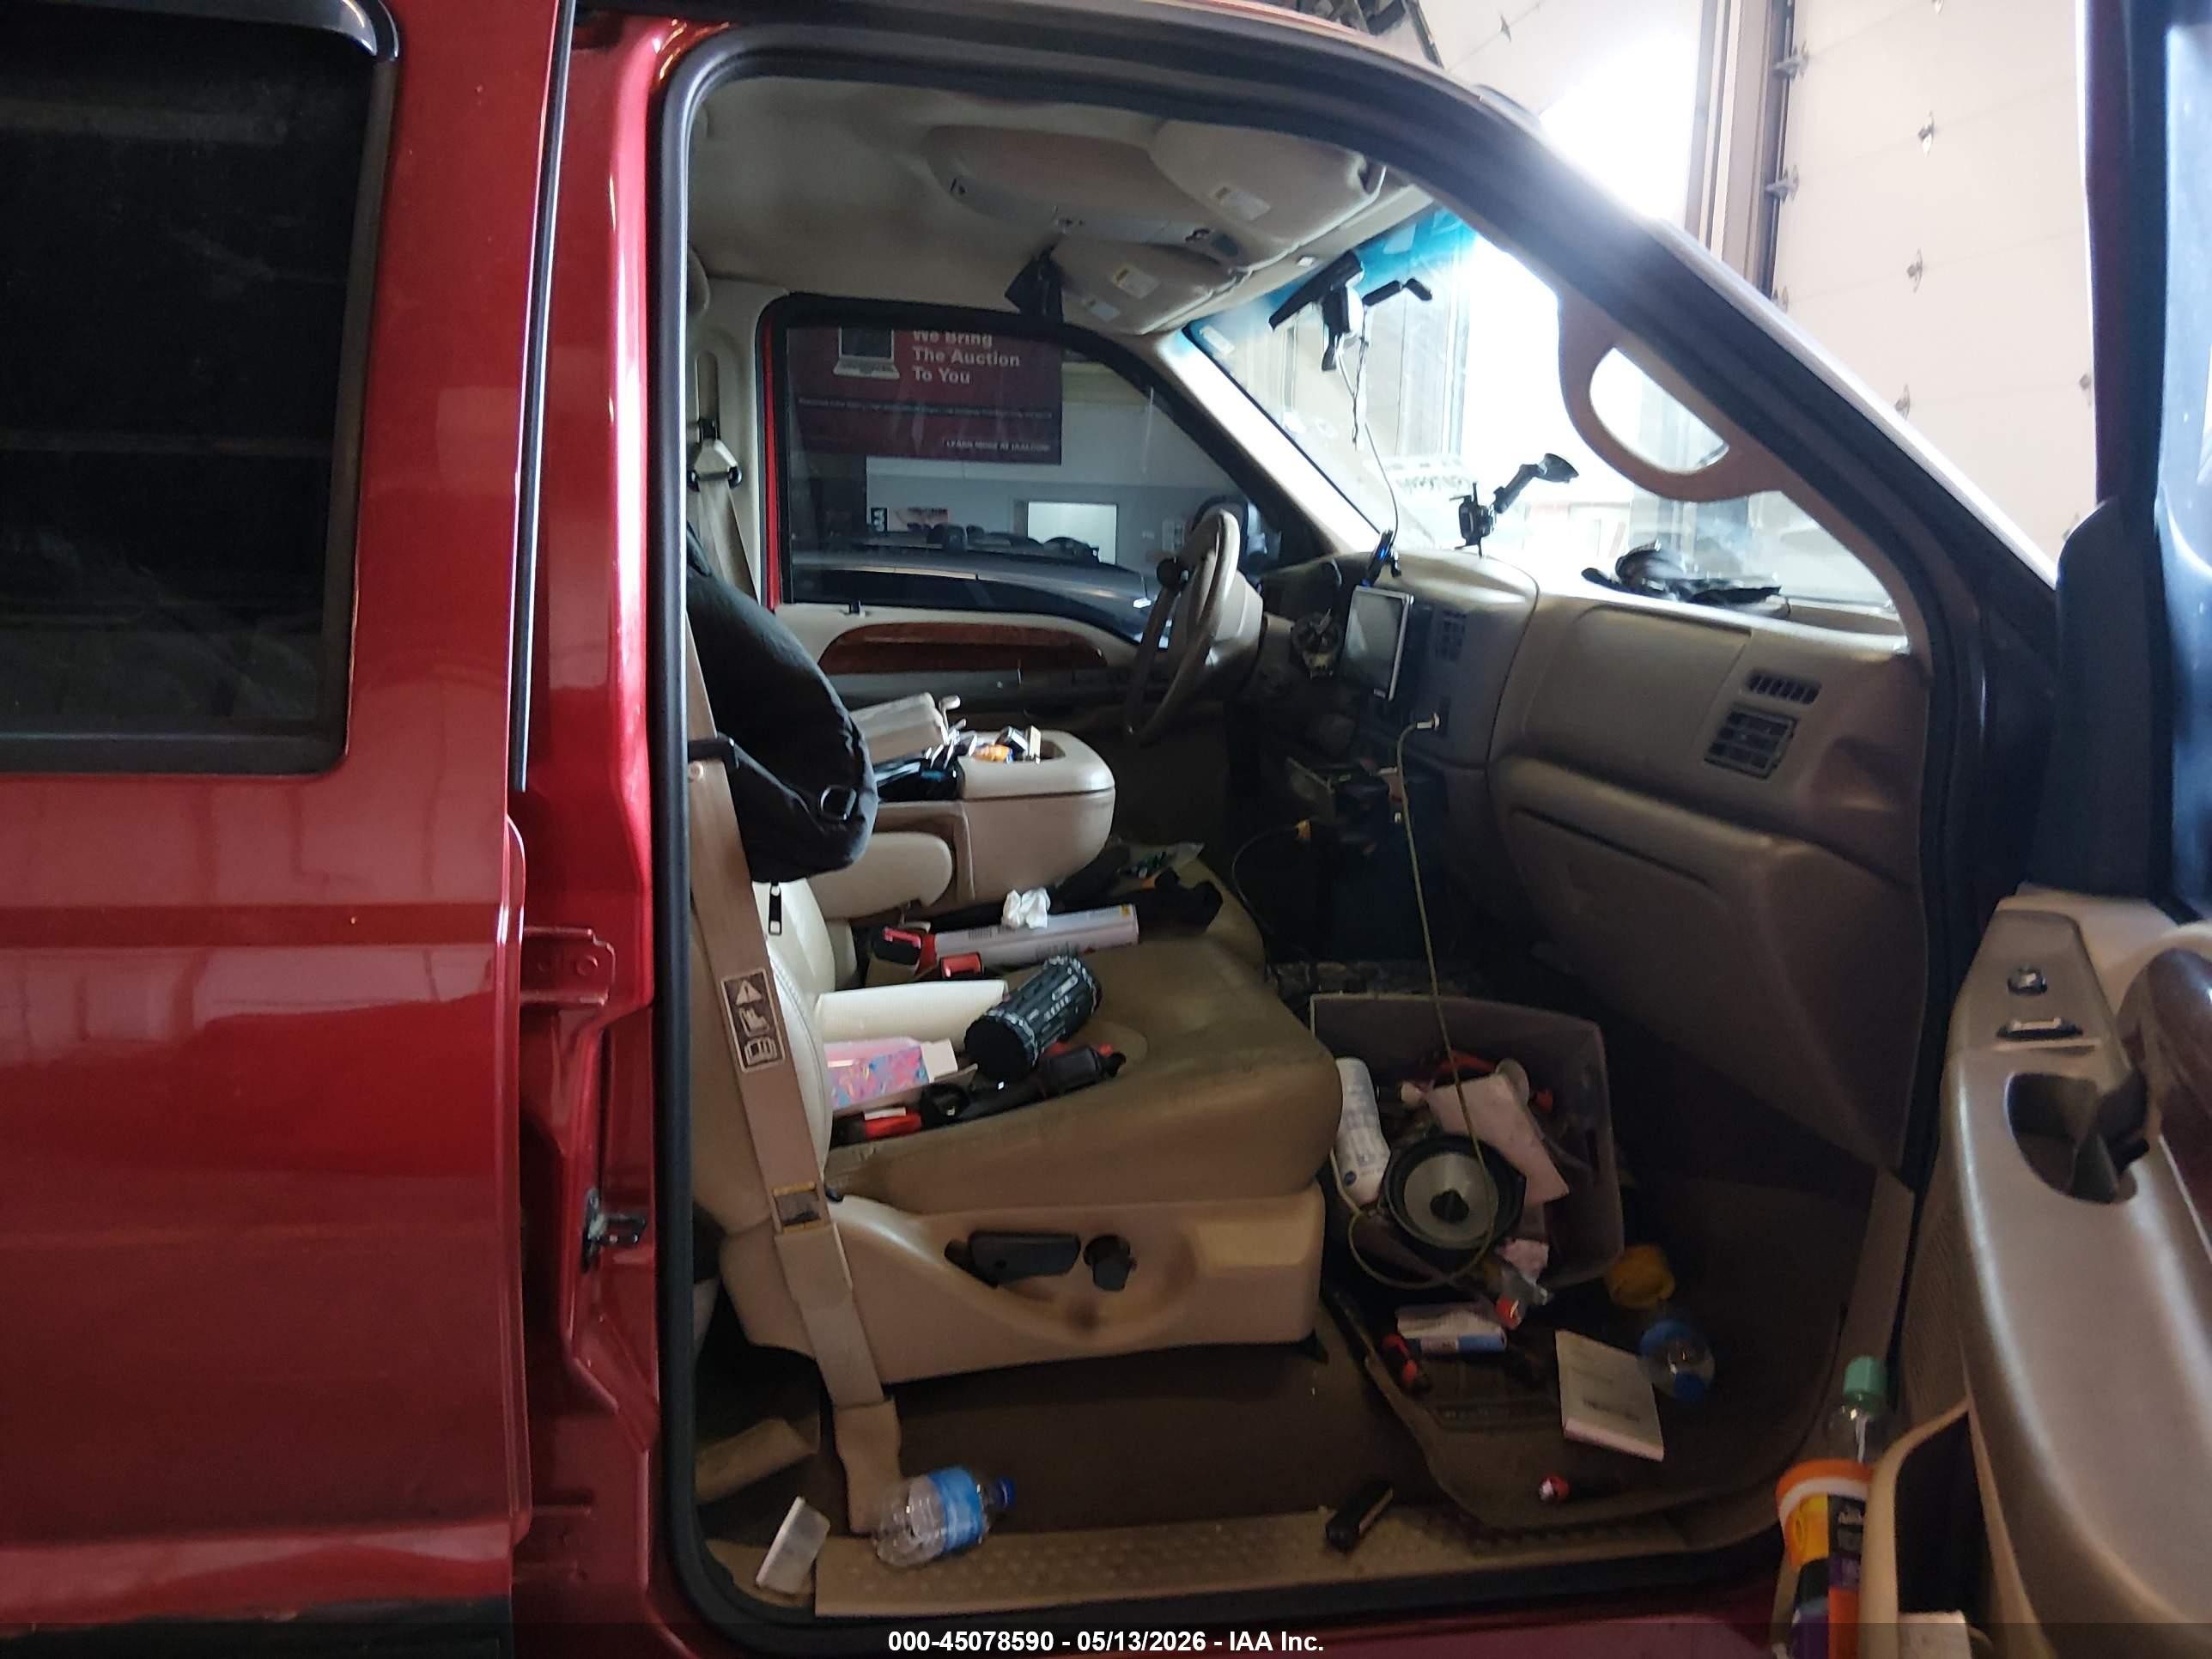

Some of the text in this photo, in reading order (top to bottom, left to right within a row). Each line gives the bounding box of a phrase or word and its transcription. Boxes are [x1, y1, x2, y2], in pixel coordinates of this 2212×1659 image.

[913, 330, 993, 349] We Bring
[912, 346, 1020, 367] The Auction
[912, 365, 970, 384] To You
